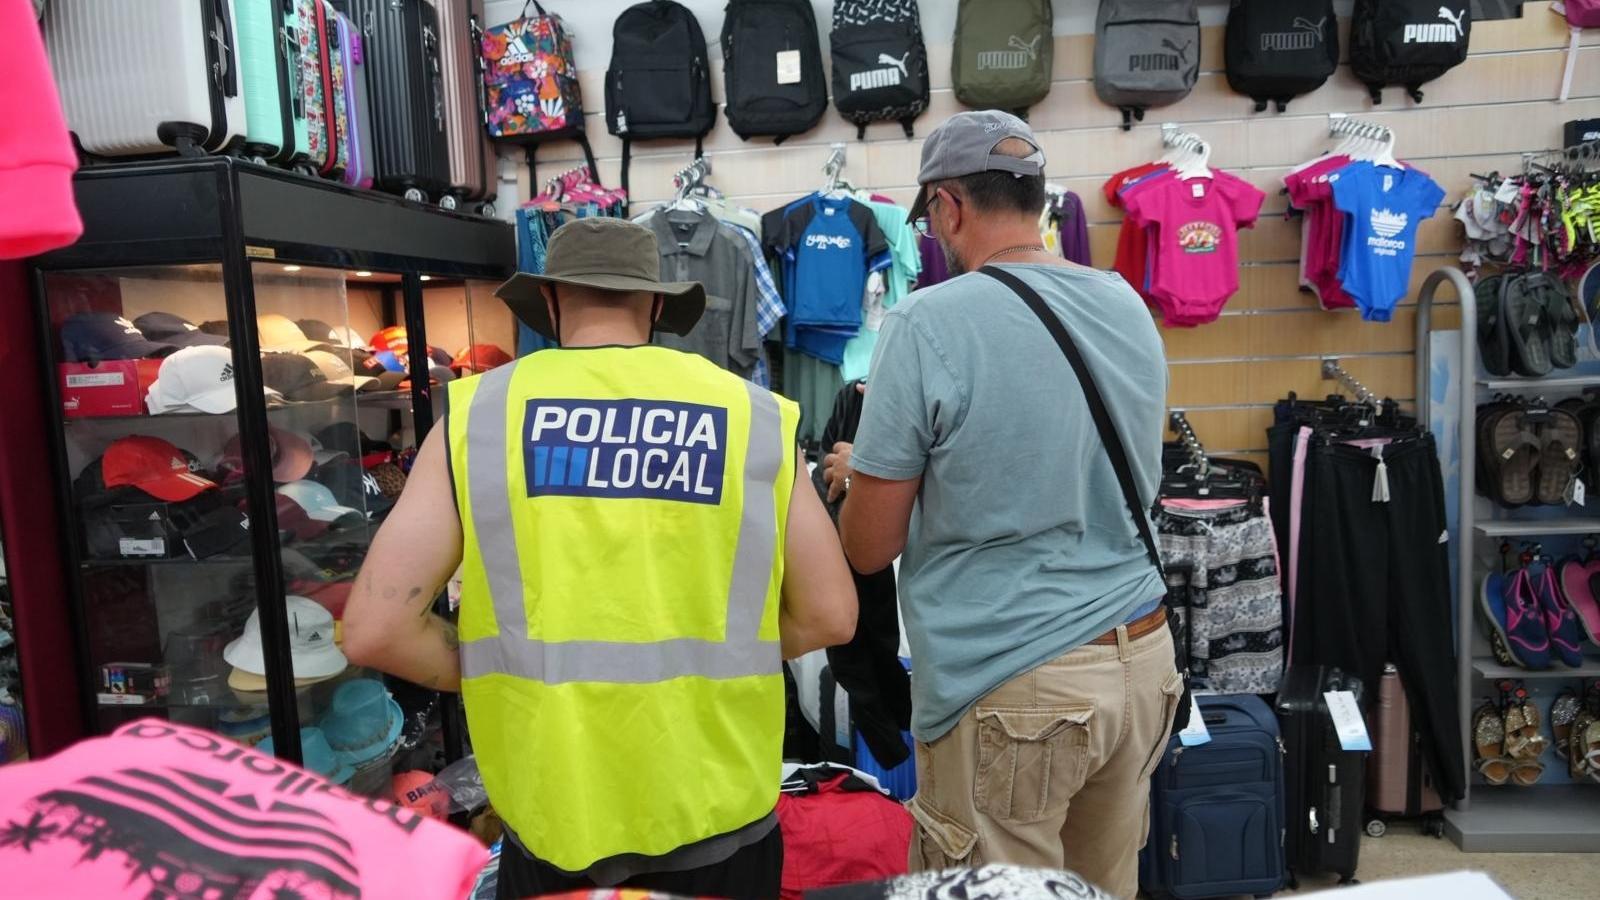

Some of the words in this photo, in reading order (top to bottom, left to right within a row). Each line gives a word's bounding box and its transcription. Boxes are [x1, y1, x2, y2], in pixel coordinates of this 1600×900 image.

[1261, 32, 1315, 50] PUMA
[1403, 24, 1457, 43] PUMA
[500, 53, 535, 65] adidas
[977, 51, 1028, 70] PUMA
[1129, 53, 1180, 71] PUMA
[850, 67, 900, 91] PUMA
[531, 406, 717, 450] POLICIA
[587, 447, 714, 495] LOCAL
